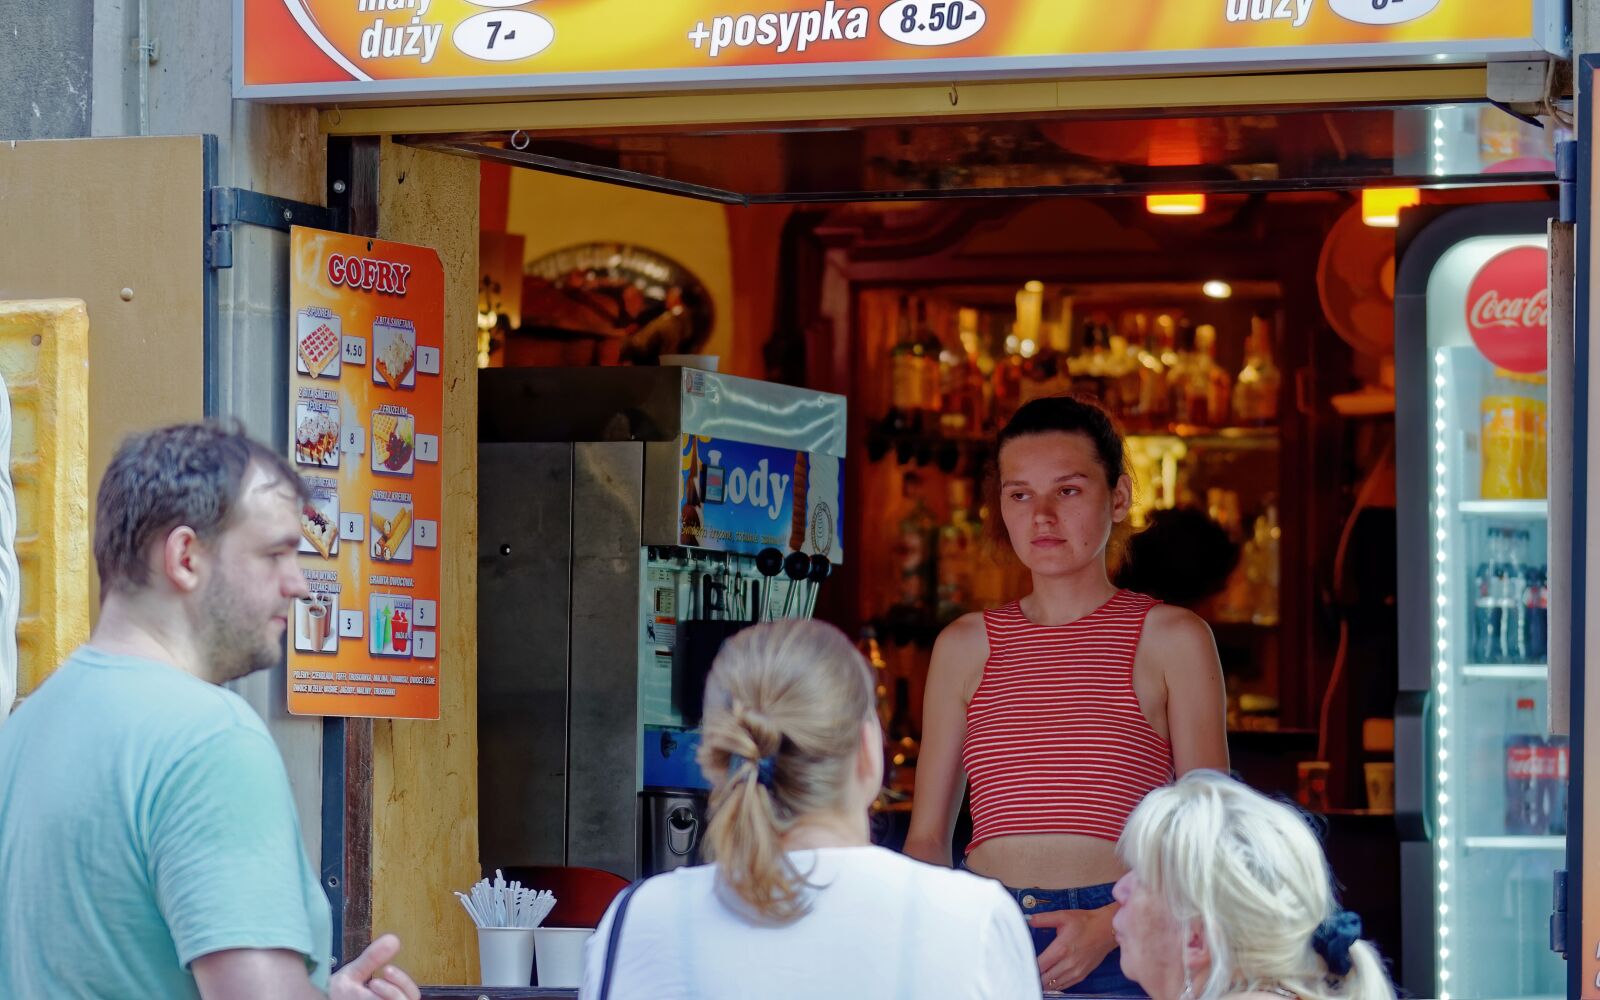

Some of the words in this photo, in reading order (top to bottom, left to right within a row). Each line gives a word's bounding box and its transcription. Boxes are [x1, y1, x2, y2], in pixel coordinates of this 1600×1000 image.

[688, 0, 869, 57] +posypka
[360, 18, 442, 63] duży
[328, 253, 410, 294] GOFRY
[345, 343, 363, 357] 4.50
[424, 353, 430, 365] 7
[349, 432, 355, 445] 8
[423, 441, 429, 454] 7
[349, 521, 355, 533] 8
[420, 526, 426, 538] 3
[419, 607, 425, 620] 5
[346, 617, 352, 630] 5
[419, 637, 425, 650] 7
